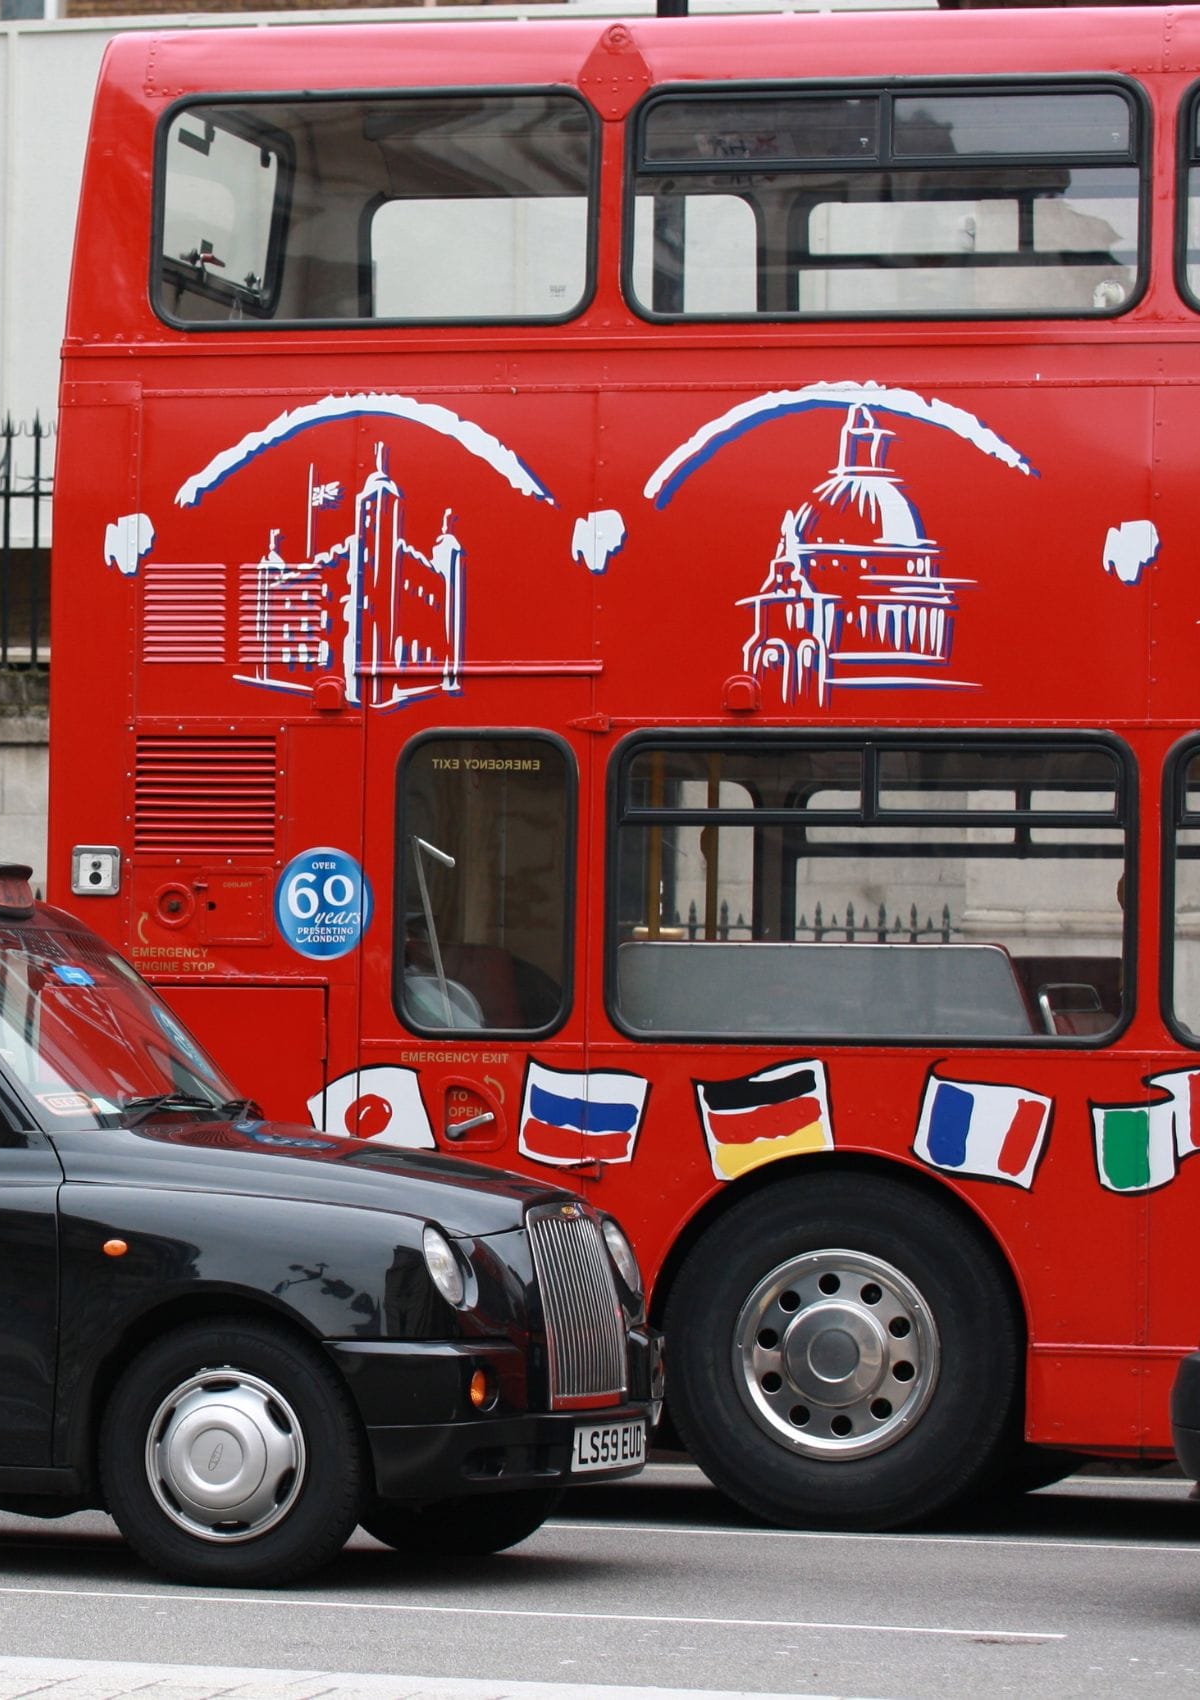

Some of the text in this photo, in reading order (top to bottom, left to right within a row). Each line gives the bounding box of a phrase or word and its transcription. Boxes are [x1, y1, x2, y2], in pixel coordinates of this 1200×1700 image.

[311, 861, 336, 870] OVER
[287, 872, 354, 919] 60
[314, 910, 362, 931] years
[297, 926, 354, 935] PRESENTING
[295, 934, 346, 943] LONDON
[131, 946, 209, 958] EMERGENCY
[133, 961, 216, 972] ENGINE STOP
[400, 1051, 510, 1064] EMERGENCY EXIT
[452, 1090, 469, 1102] TO
[448, 1106, 483, 1118] OPEN
[578, 1425, 642, 1465] LS59 EUD
